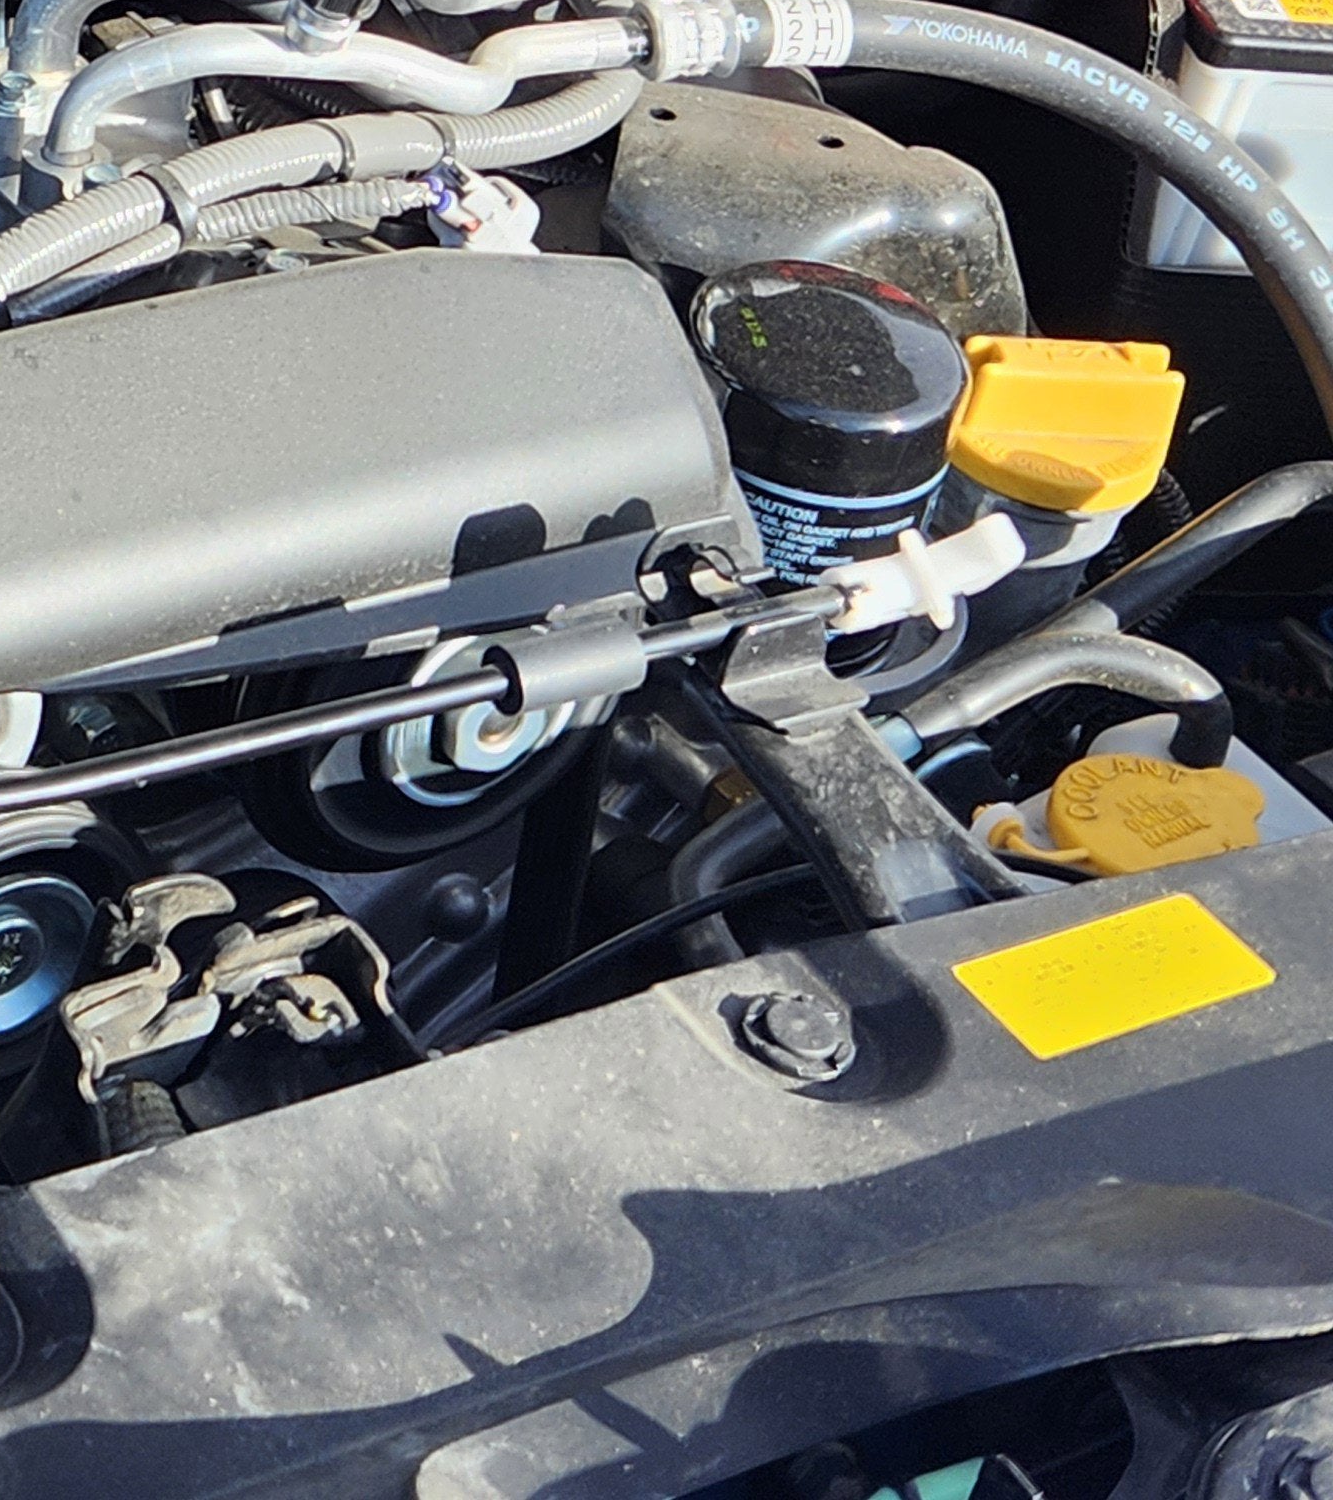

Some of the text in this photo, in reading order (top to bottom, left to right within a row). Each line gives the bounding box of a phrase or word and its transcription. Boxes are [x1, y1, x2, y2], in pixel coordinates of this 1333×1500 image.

[789, 19, 834, 41] 2 H
[913, 17, 1029, 59] YOKOHAMA
[1060, 56, 1151, 112] ACVR
[1217, 153, 1258, 194] HP
[1265, 206, 1306, 251] 9H
[745, 492, 819, 525] CAUTION
[1063, 757, 1187, 821] COOLANT
